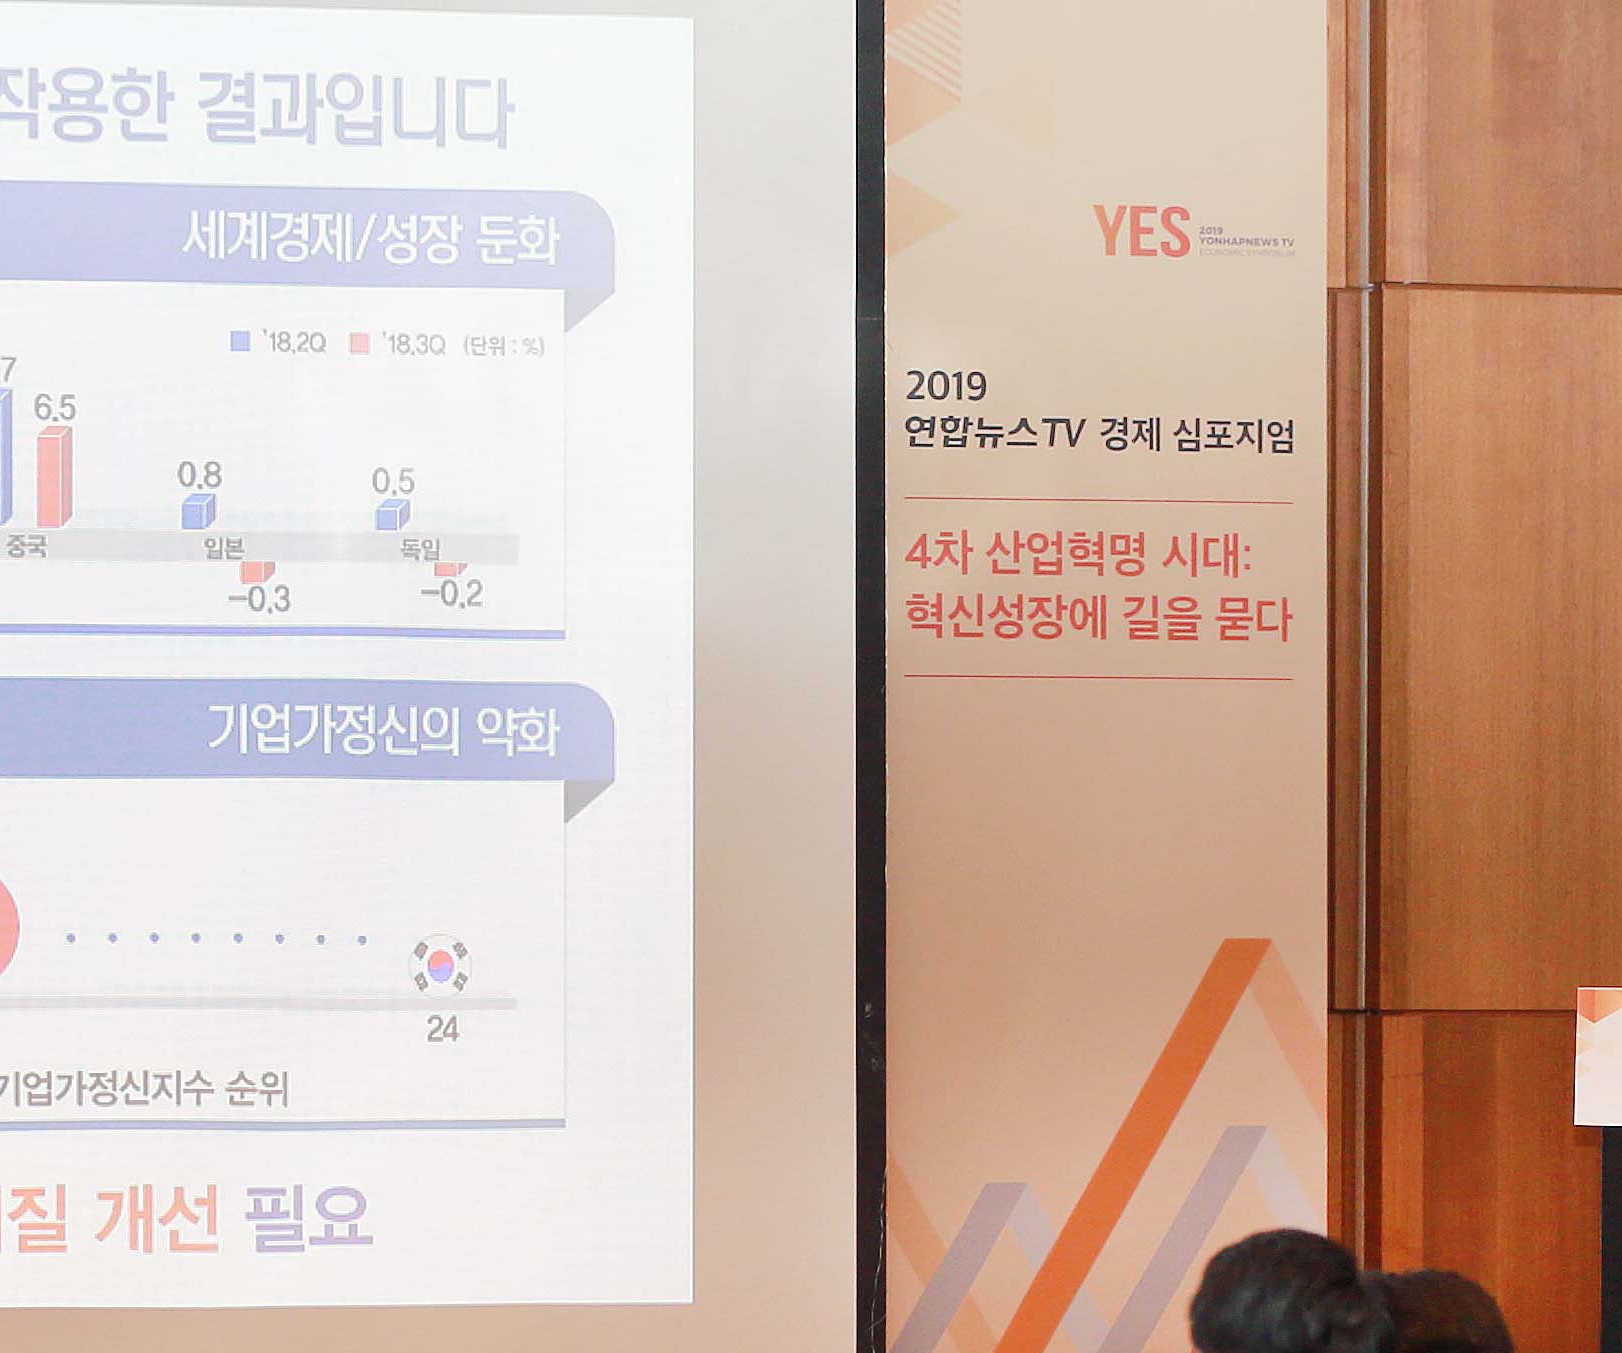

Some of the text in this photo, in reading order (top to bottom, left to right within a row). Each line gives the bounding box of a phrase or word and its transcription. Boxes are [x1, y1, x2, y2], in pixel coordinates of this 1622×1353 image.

[197, 71, 516, 150] 결과입니다
[181, 209, 561, 268] 세계경제/성장 둔화
[1093, 204, 1191, 258] YES
[906, 370, 987, 402] 2019
[34, 393, 76, 423] 6.5
[905, 415, 1294, 454] 연합뉴스TV 경제 심포지엄
[177, 460, 223, 490] 0.8
[372, 466, 415, 497] 0.5
[5, 534, 47, 559] 중국
[203, 536, 245, 561] 일본
[400, 538, 440, 562] 독일
[904, 529, 1251, 579] 4차 산업혁명 시대:
[905, 592, 1294, 643] 혁신성장에 길을 묻다
[208, 703, 562, 757] 기업가정신의 약화
[427, 1014, 460, 1043] 24
[224, 1070, 288, 1108] 순위
[94, 1183, 219, 1254] 개선
[244, 1183, 374, 1254] 필요
